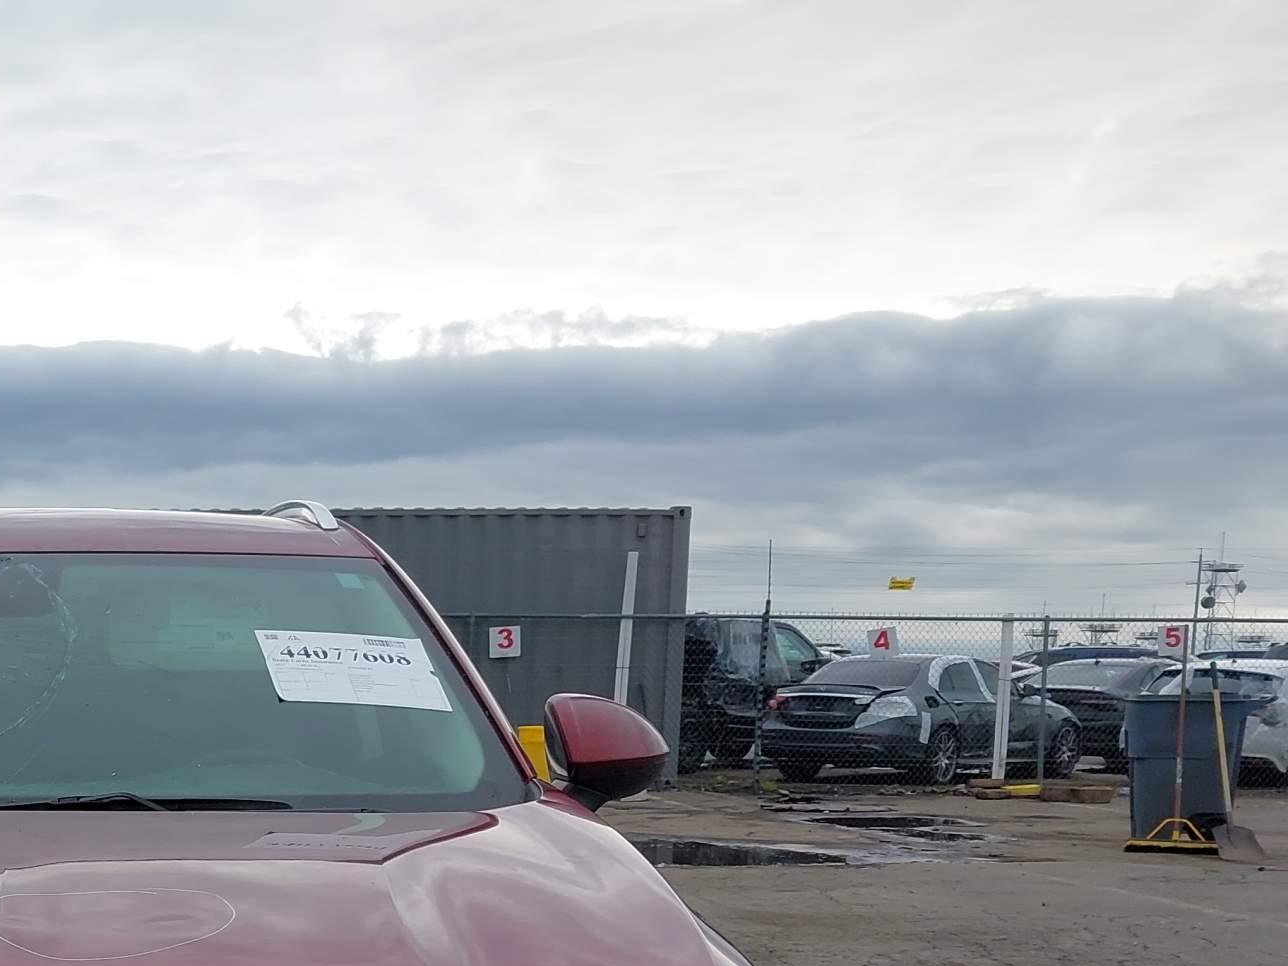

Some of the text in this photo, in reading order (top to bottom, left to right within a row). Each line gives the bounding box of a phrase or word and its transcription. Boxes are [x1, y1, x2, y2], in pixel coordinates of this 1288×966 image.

[498, 629, 513, 649] 3
[873, 629, 890, 650] 4
[1165, 628, 1181, 647] 5
[280, 645, 412, 666] 44077608
